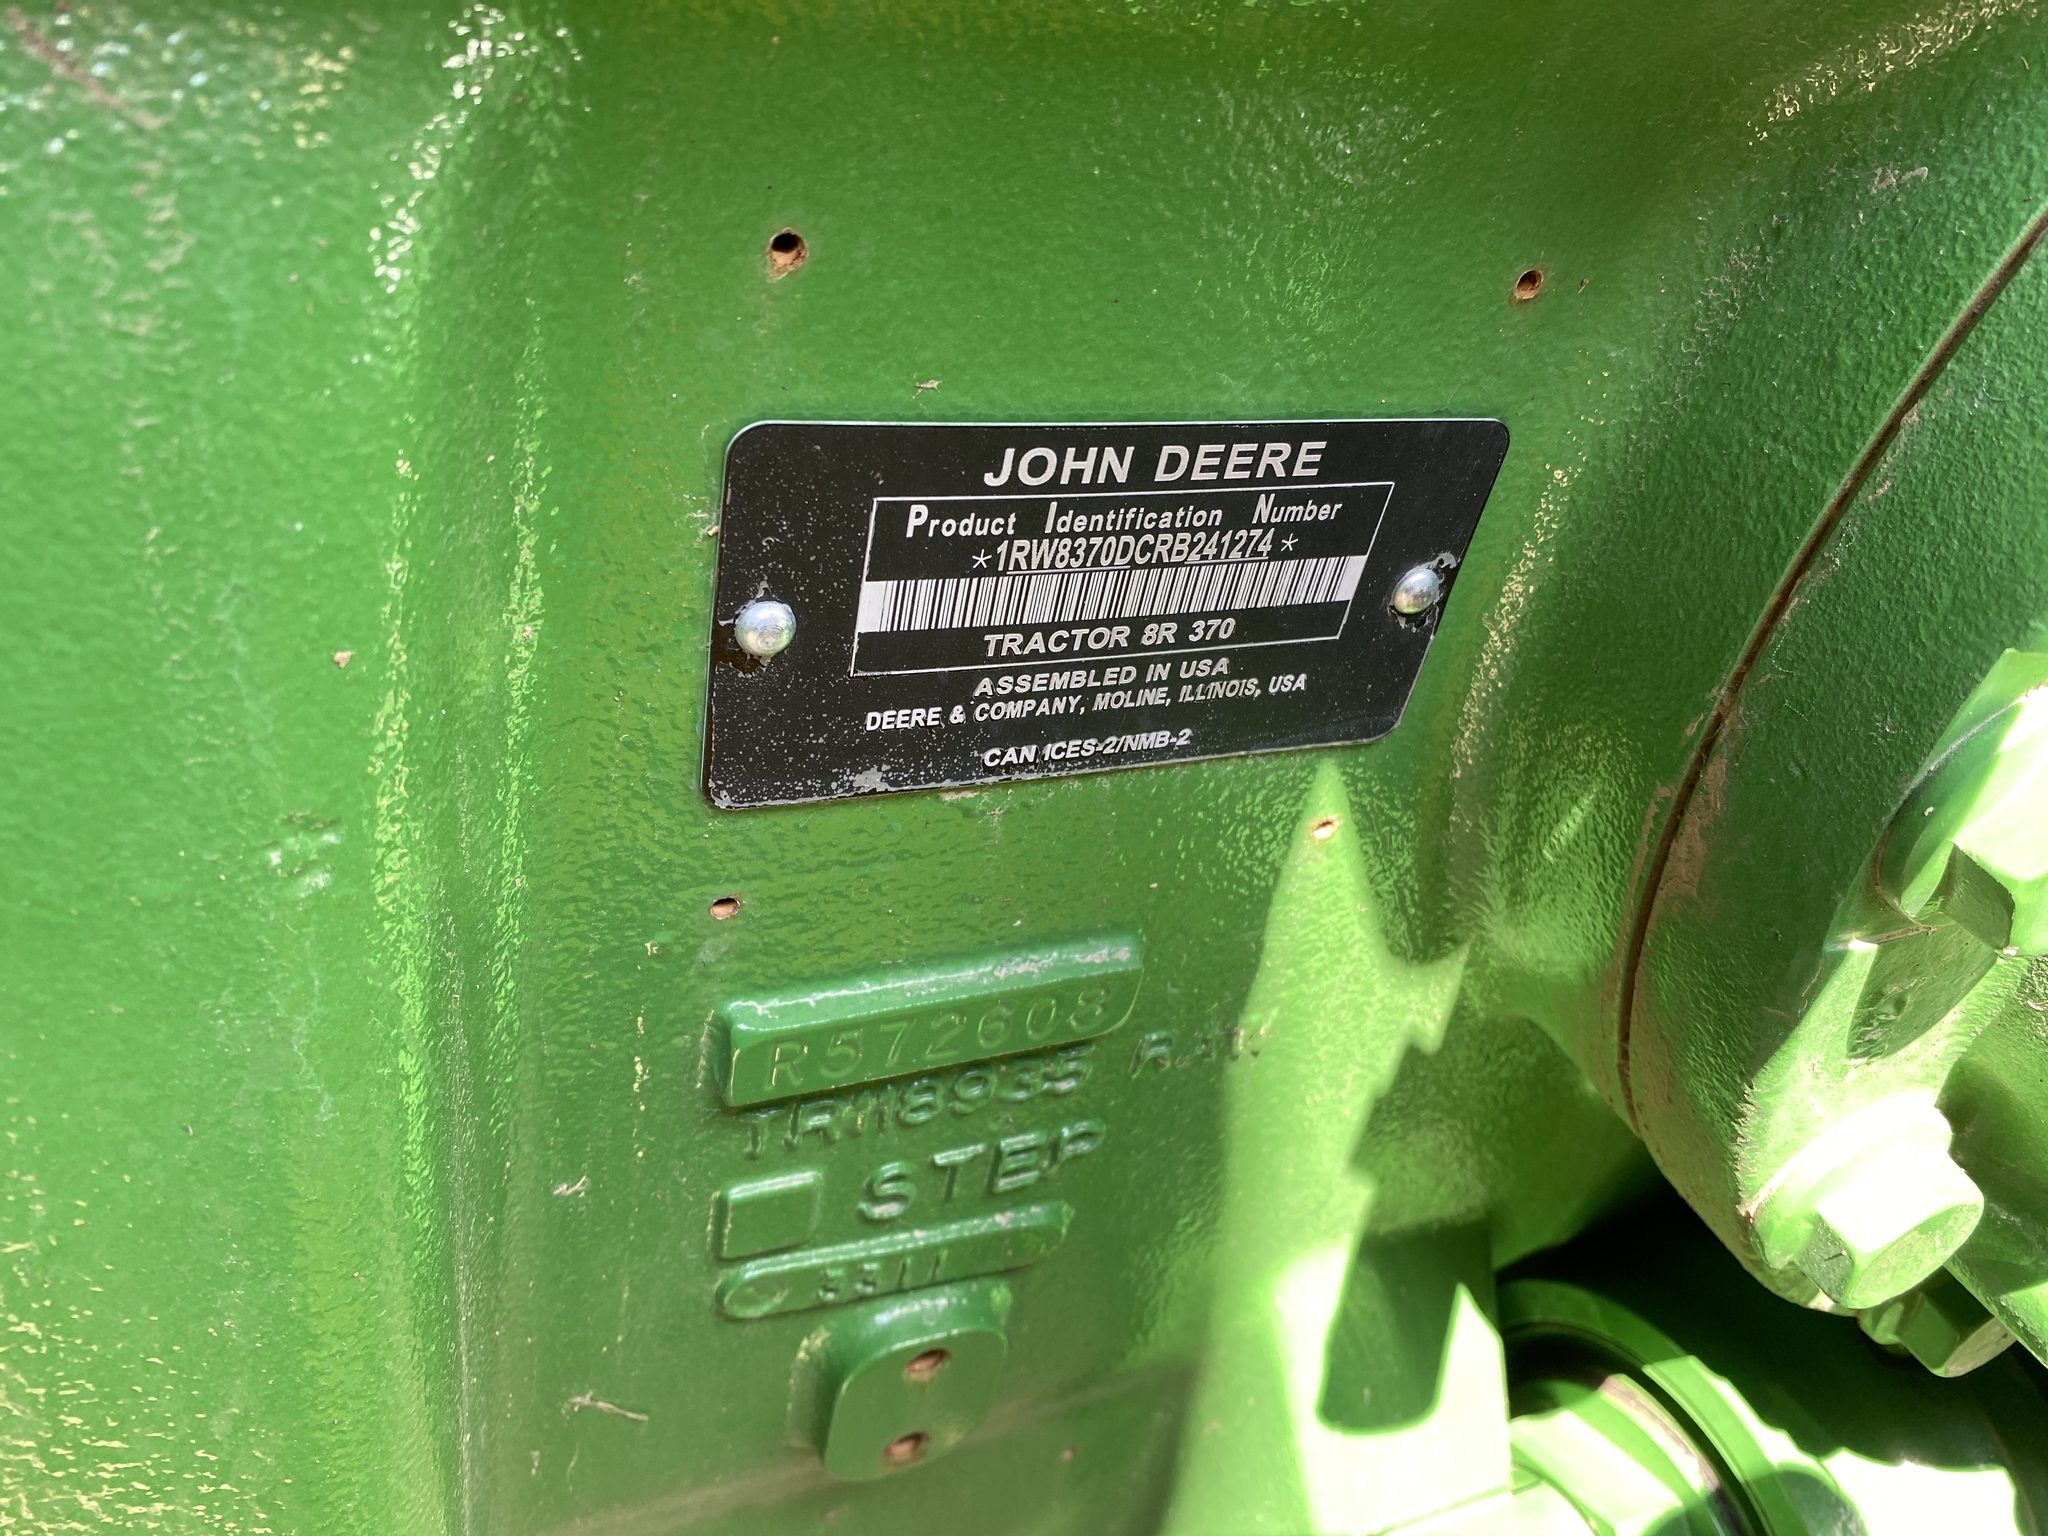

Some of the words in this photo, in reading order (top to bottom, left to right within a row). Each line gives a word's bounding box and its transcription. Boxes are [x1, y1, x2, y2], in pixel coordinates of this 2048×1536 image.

[984, 446, 1134, 487] JOHN
[1154, 441, 1327, 482] DEERE
[906, 505, 1016, 538] Product
[1045, 501, 1223, 534] Identification
[1252, 493, 1343, 523] Number
[983, 625, 1131, 658] TRACTOR
[1141, 622, 1177, 646] 8R
[1189, 618, 1236, 642] 370
[973, 667, 1136, 698] ASSEMBLED
[1146, 663, 1171, 683] IN
[1179, 657, 1230, 679] USA
[865, 707, 941, 732] DEERE
[949, 705, 966, 724] &
[974, 694, 1085, 723] COMPANY,
[1092, 687, 1173, 712] MOLINE,
[1178, 678, 1262, 703] ILLINOIS,
[1268, 673, 1308, 695] USA
[984, 744, 1037, 767] CAN
[1043, 728, 1192, 761] ICES-2/NMB-2
[857, 1117, 1107, 1220] STEP
